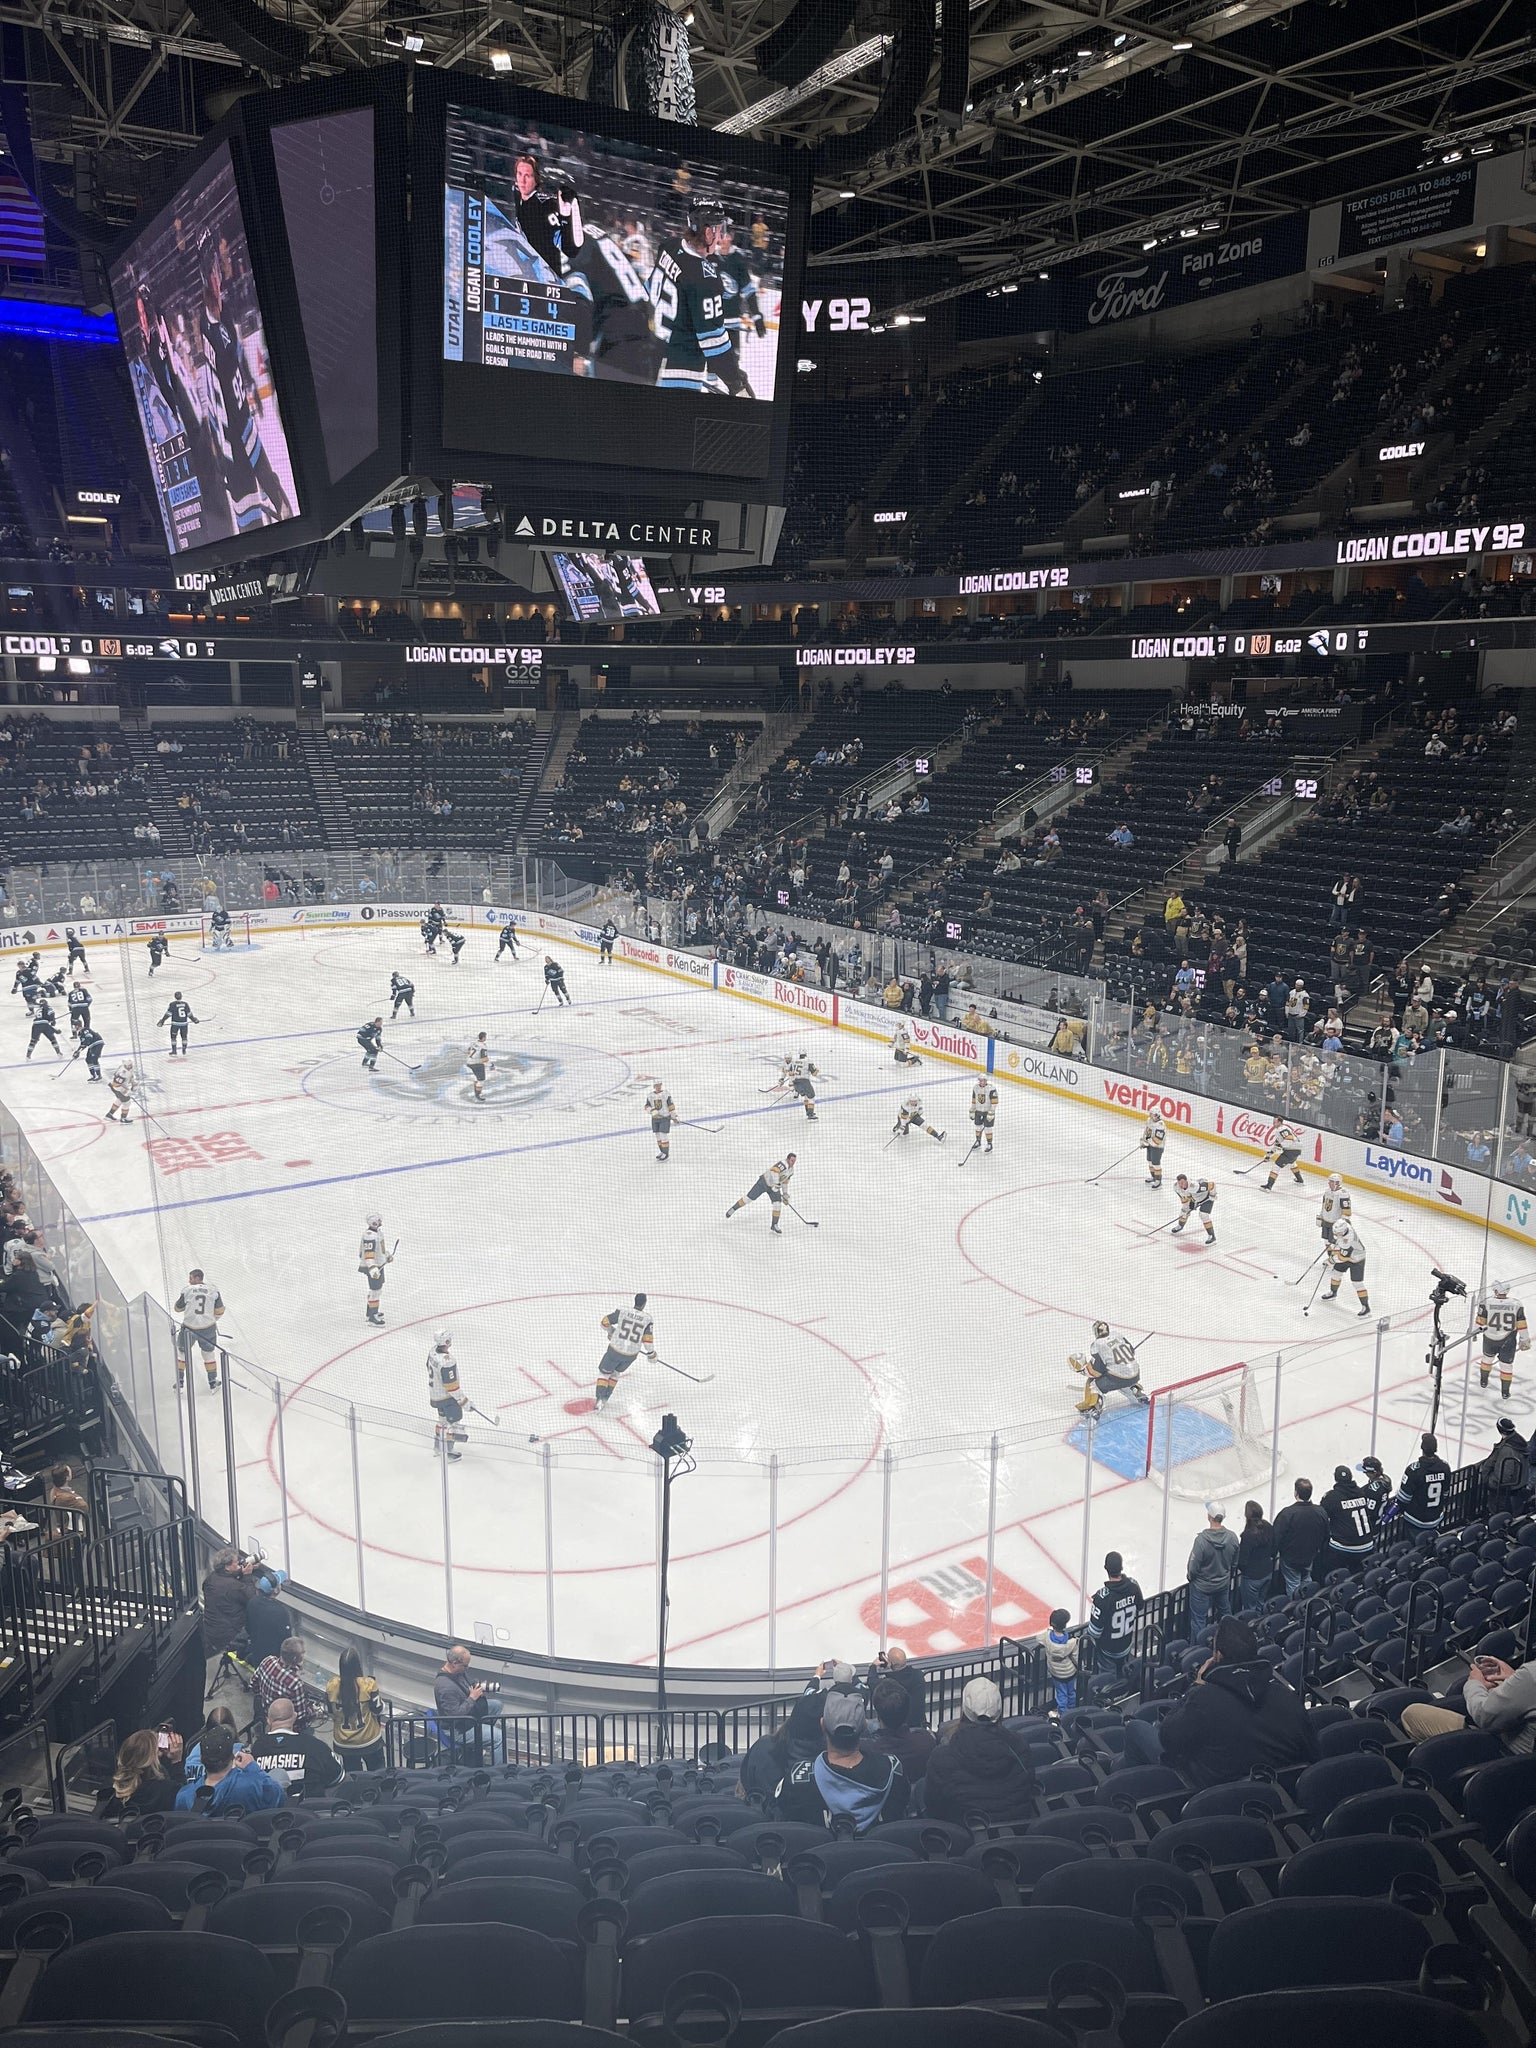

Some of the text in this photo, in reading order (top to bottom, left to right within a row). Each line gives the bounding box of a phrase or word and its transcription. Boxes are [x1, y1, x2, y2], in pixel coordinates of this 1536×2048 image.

[1346, 170, 1472, 213] TEXT SOS DELTA TO 848-261
[467, 195, 482, 312] LOGAN COOLEY
[1182, 252, 1214, 275] Fan
[1217, 237, 1263, 265] Zone
[493, 278, 561, 299] G A PTS
[1088, 265, 1169, 325] Ford
[493, 294, 558, 319] 1 3 4
[702, 294, 724, 320] 92
[828, 297, 871, 331] 92
[449, 299, 460, 347] UTAH
[491, 315, 569, 337] LAST 5 GAMES
[485, 331, 505, 343] LEADS
[505, 334, 517, 345] THE
[517, 336, 547, 348] MAMMOTH
[485, 344, 556, 361] GOALS ON THE ROAD THIS
[485, 355, 509, 367] SEASON
[1378, 442, 1426, 461] COOLEY
[78, 491, 121, 504] COOLEY
[873, 511, 908, 523] COOLEY
[542, 518, 713, 546] DELTA CENTER
[1336, 524, 1525, 564] LOGAN COOLEY 92
[959, 567, 1070, 595] LOGAN COOLEY 92
[214, 580, 264, 604] DELTA CENTER
[704, 587, 726, 603] 92
[81, 639, 94, 654] 0
[126, 644, 154, 656] 6:02
[186, 642, 197, 657] 0
[1131, 637, 1170, 659] LOGAN
[1234, 637, 1245, 654] 0
[1274, 639, 1302, 653] 6:02
[1335, 632, 1348, 650] 0
[405, 646, 543, 664] LOGAN COOLEY 92
[795, 648, 916, 666] LOGAN COOLEY 92
[504, 664, 541, 680] G2G
[915, 758, 929, 773] 92
[1076, 767, 1093, 784] 92
[1295, 778, 1318, 799] 92
[306, 911, 351, 921] SameDay
[377, 908, 431, 918] 1Password
[499, 912, 527, 923] moxie
[136, 921, 167, 931] SME
[620, 938, 660, 964] Trucordia
[674, 955, 710, 977] Ken Garff
[70, 991, 84, 1002] 28
[178, 1007, 187, 1018] 6
[931, 1026, 978, 1060] Smith's
[1023, 1057, 1079, 1086] OKLAND
[1103, 1079, 1192, 1124] verizon
[1365, 1147, 1432, 1184] Layton
[194, 1294, 207, 1315] 3
[618, 1319, 645, 1343] 55
[1488, 1312, 1516, 1332] 49
[1112, 1344, 1136, 1364] 40
[1426, 1482, 1443, 1508] 9
[1351, 1508, 1371, 1537] 11
[1115, 1594, 1136, 1610] COOLEY
[1110, 1607, 1137, 1640] 92
[256, 1753, 306, 1770] SIMASHEV
